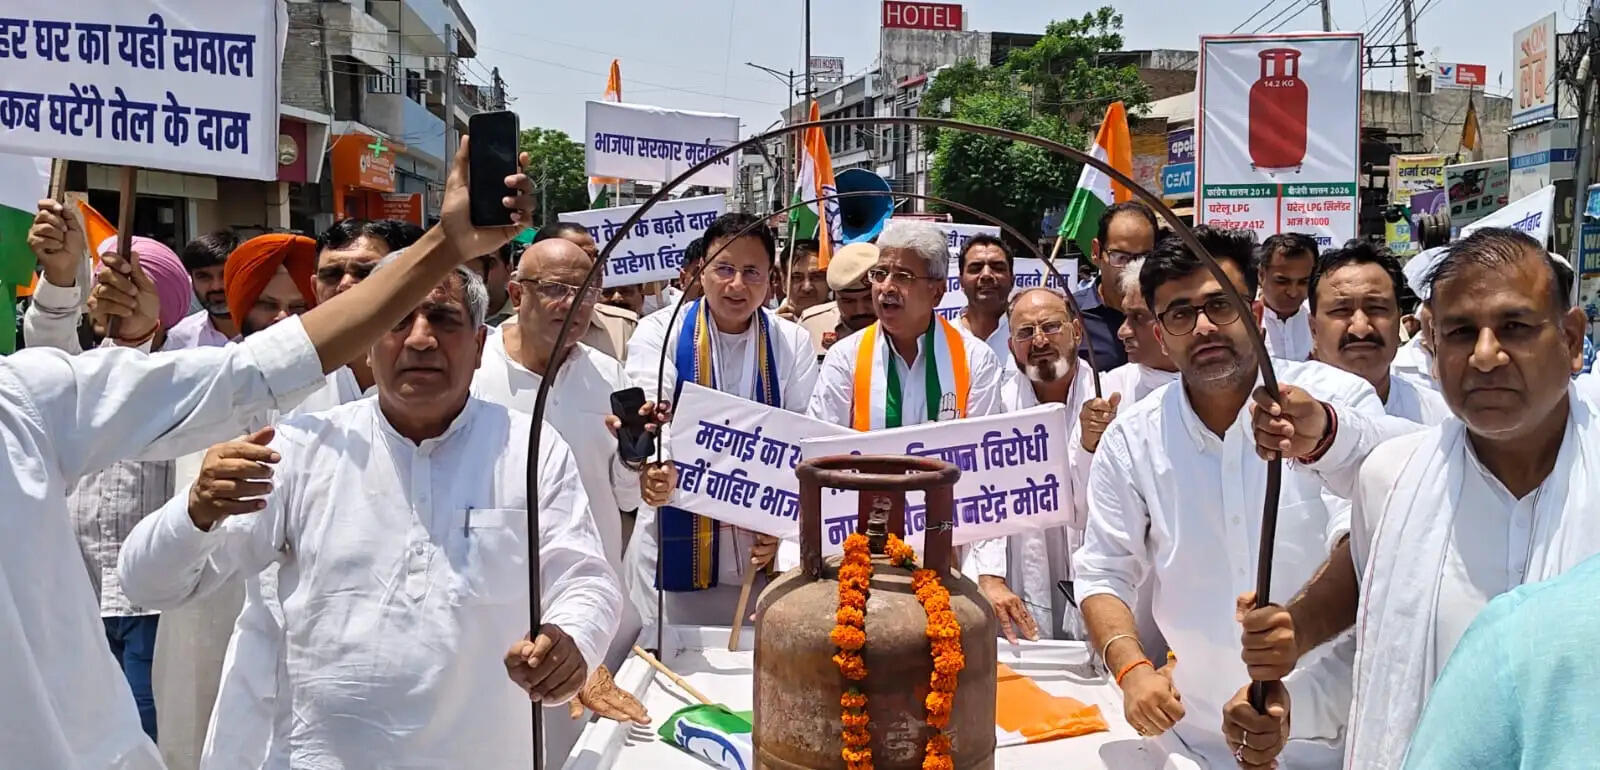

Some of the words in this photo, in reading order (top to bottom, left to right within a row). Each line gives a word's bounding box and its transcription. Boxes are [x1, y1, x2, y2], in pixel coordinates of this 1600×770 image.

[887, 4, 956, 28] HOTEL
[33, 21, 71, 62] घर
[75, 22, 111, 65] का
[115, 13, 167, 70] यही
[171, 29, 256, 78] सवाल
[1264, 80, 1280, 88] 14.2
[1282, 79, 1294, 87] KG
[0, 90, 44, 132] कब
[48, 83, 105, 138] घटेंगे
[109, 86, 157, 143] तेल
[162, 91, 191, 146] के
[195, 108, 251, 154] दाम
[595, 132, 635, 156] भाजपा
[636, 137, 682, 161] सरकार
[1171, 134, 1194, 158] apol
[1166, 171, 1191, 188] CEAT
[1330, 186, 1350, 194] 2026
[1250, 188, 1271, 196] 2014
[1208, 202, 1232, 216] घरेलू
[1232, 203, 1250, 213] LPG
[1287, 201, 1306, 215] घरेलू
[1306, 202, 1322, 212] LPG
[1324, 200, 1351, 212] सिलेंडर
[651, 210, 686, 239] बढ़ते
[686, 210, 719, 231] दाम
[1287, 217, 1304, 227] आज
[1305, 217, 1329, 226] ₹1000
[610, 250, 656, 275] सहेगा
[695, 419, 760, 462] महंगाई
[759, 437, 788, 468] का
[981, 423, 1049, 471] विरोधी
[706, 468, 760, 508] चाहिए
[760, 486, 801, 521] भाज
[960, 485, 1008, 524] नरेंद्र
[1010, 473, 1060, 516] मोदी
